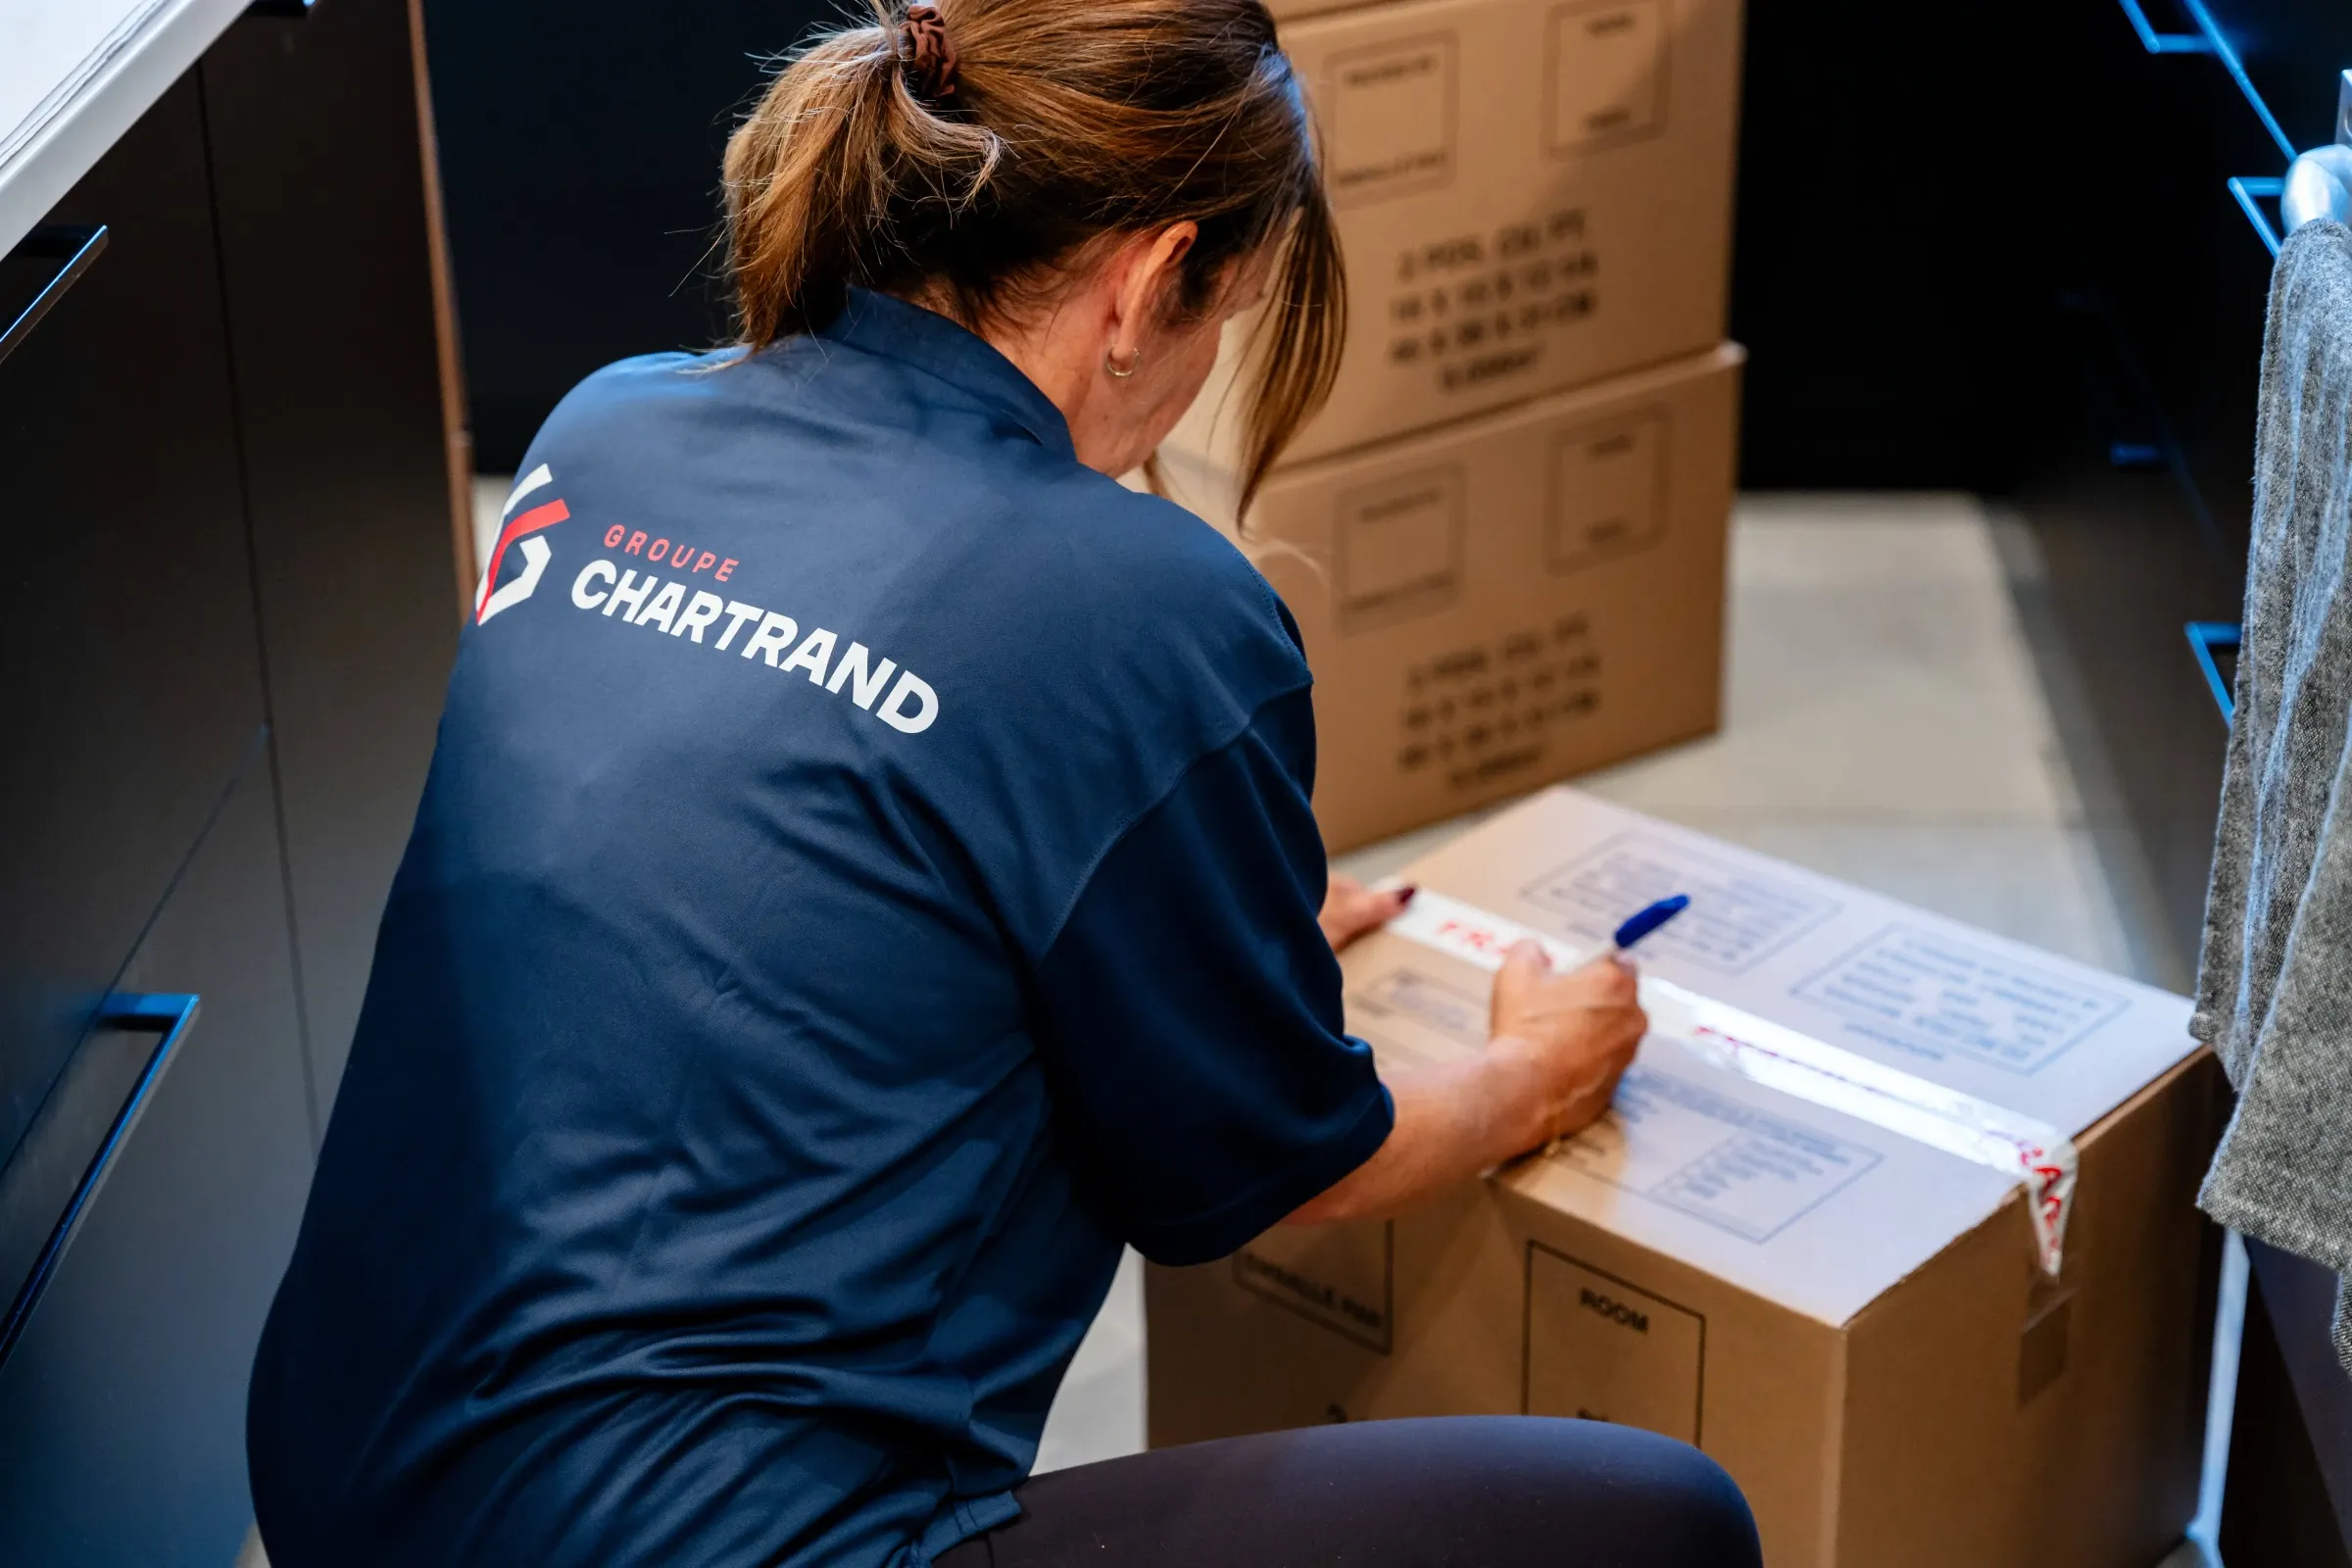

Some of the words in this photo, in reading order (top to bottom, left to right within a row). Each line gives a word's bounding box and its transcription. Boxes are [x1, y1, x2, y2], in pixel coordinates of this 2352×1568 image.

[604, 524, 739, 582] GROUPE
[570, 559, 940, 734] CHARTRAND
[1579, 1286, 1649, 1334] ROOM
